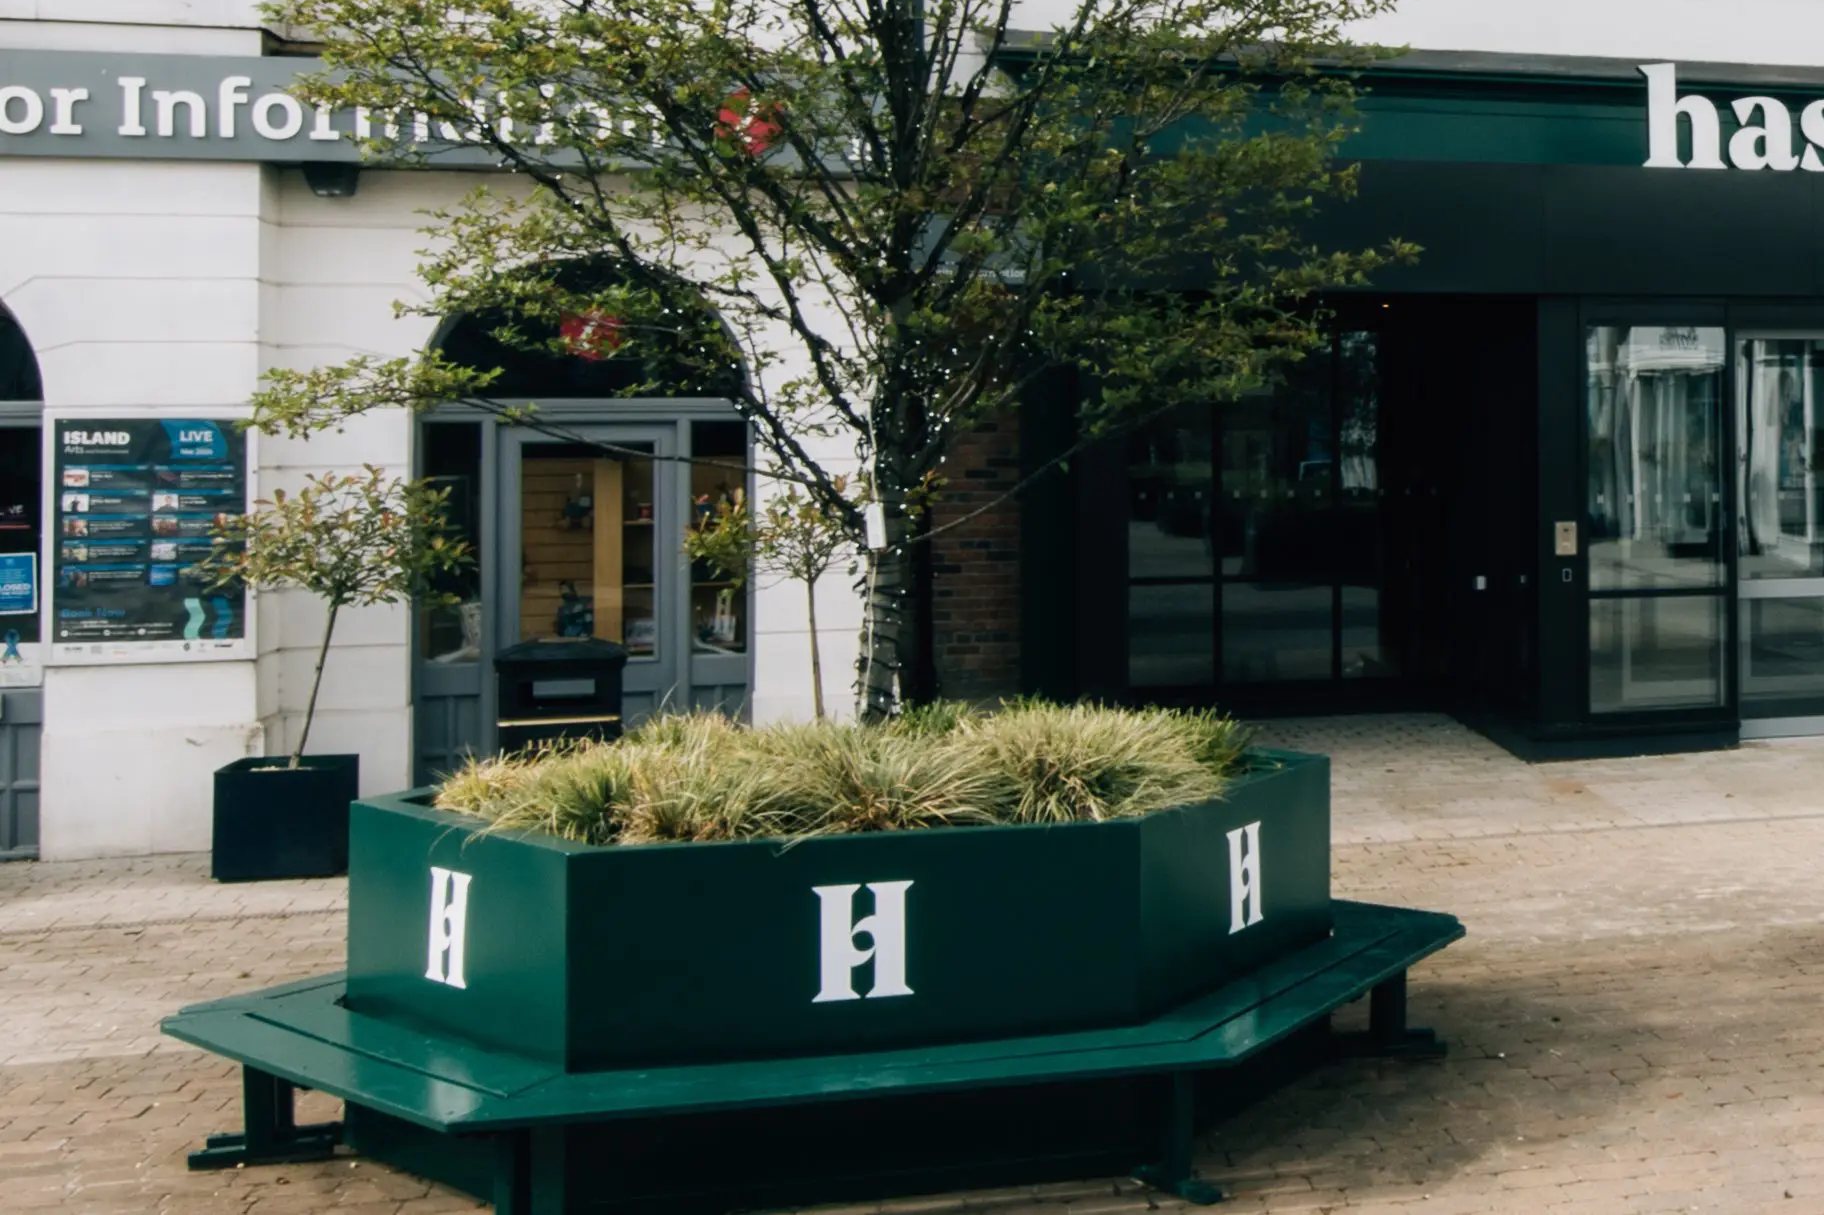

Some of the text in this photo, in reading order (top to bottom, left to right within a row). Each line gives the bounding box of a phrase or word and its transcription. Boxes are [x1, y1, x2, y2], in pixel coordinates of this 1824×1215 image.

[0, 85, 89, 135] or
[64, 430, 131, 445] ISLAND
[179, 429, 213, 442] LIVE
